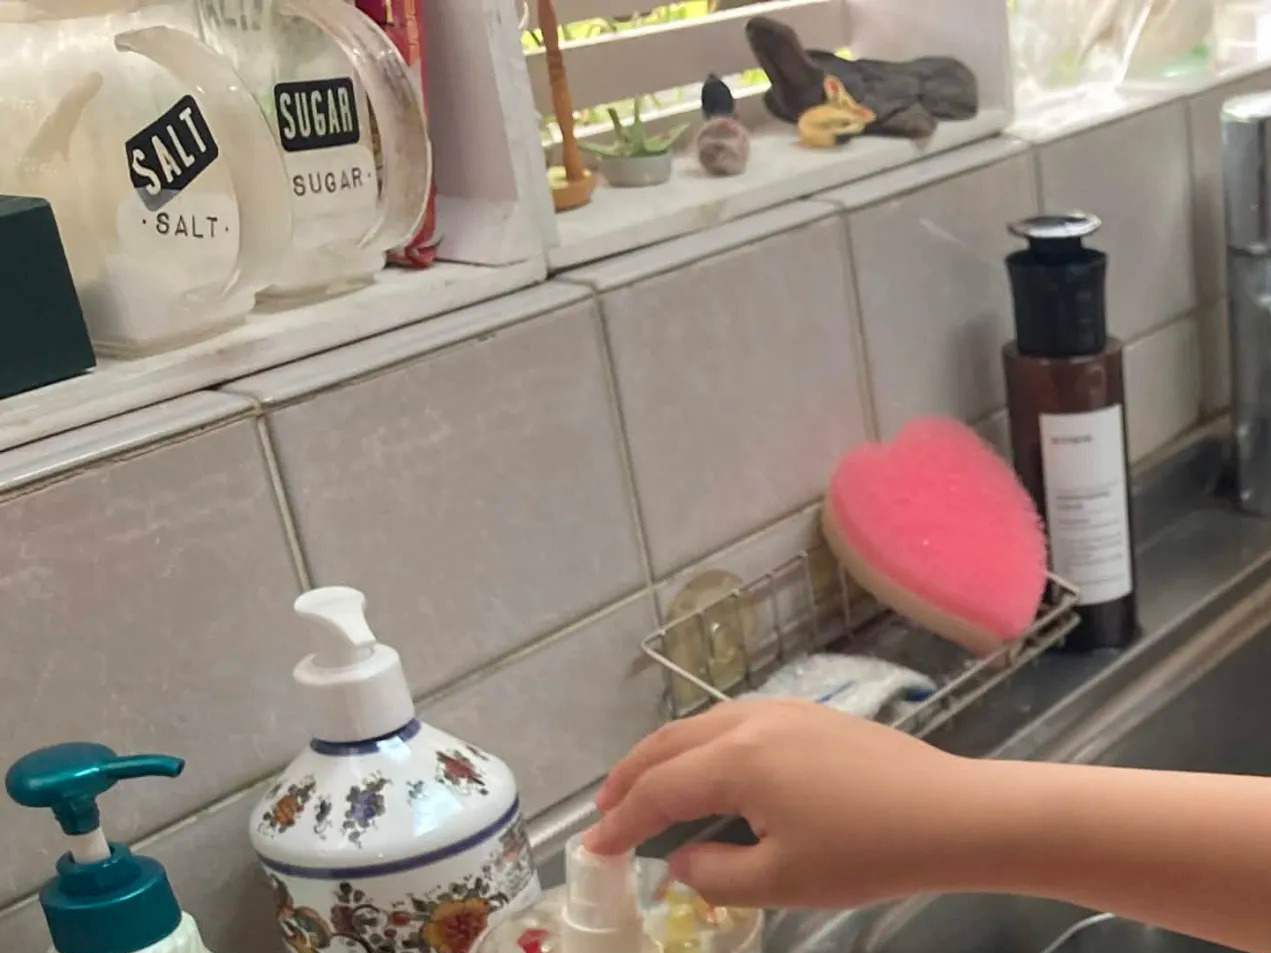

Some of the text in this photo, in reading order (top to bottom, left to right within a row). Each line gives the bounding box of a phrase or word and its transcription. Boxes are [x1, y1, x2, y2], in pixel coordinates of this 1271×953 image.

[279, 86, 354, 140] SUGAR
[131, 106, 207, 196] SALT
[292, 166, 363, 197] SUGAR
[155, 211, 218, 239] SALT
